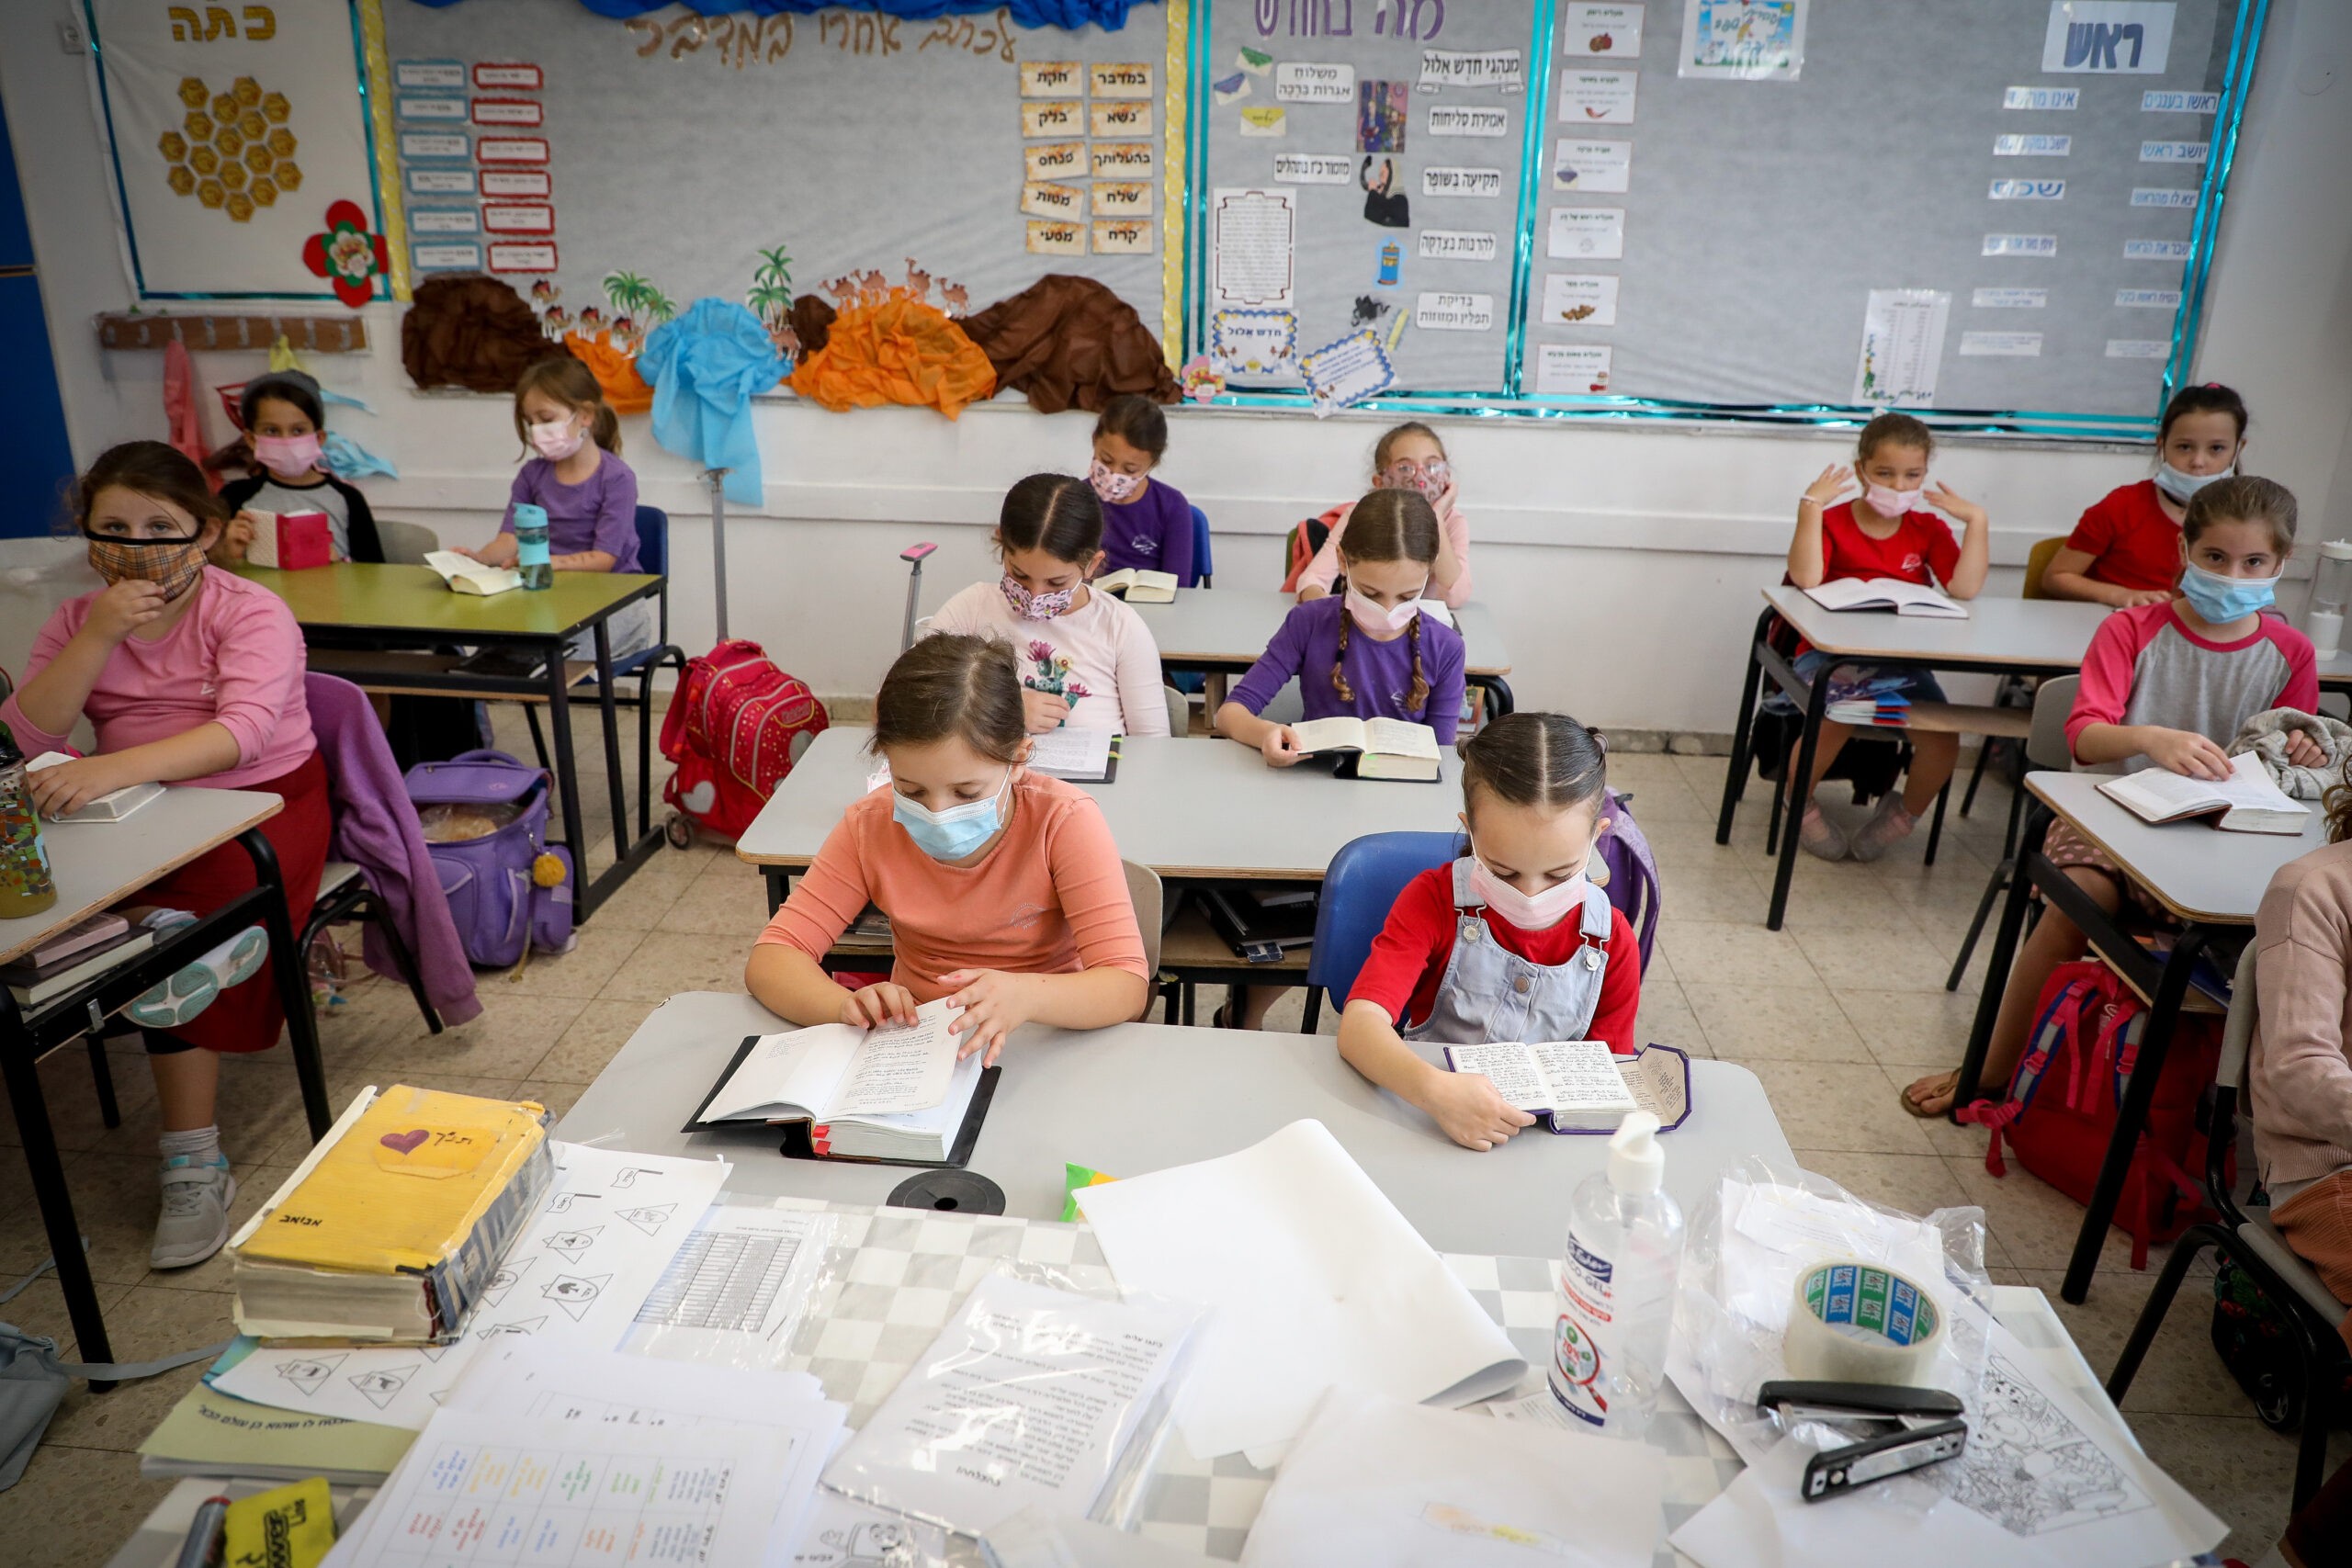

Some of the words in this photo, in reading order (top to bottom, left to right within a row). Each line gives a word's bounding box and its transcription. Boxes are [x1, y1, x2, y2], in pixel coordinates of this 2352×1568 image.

[168, 6, 277, 42] כתה
[2064, 23, 2144, 69] ראש
[1036, 71, 1069, 87] חקת
[1097, 73, 1147, 85] במדבר
[2188, 95, 2218, 110] ראשו
[1038, 109, 1069, 127] בלק
[1106, 109, 1137, 123] נשא
[2143, 144, 2174, 157] ראש
[1038, 152, 1073, 166] פנחס
[1094, 152, 1150, 166] בהעלותך
[1035, 191, 1070, 207] מטות
[1106, 189, 1140, 203] שלח
[1040, 230, 1073, 243] מסעי
[1108, 230, 1138, 244] קרח
